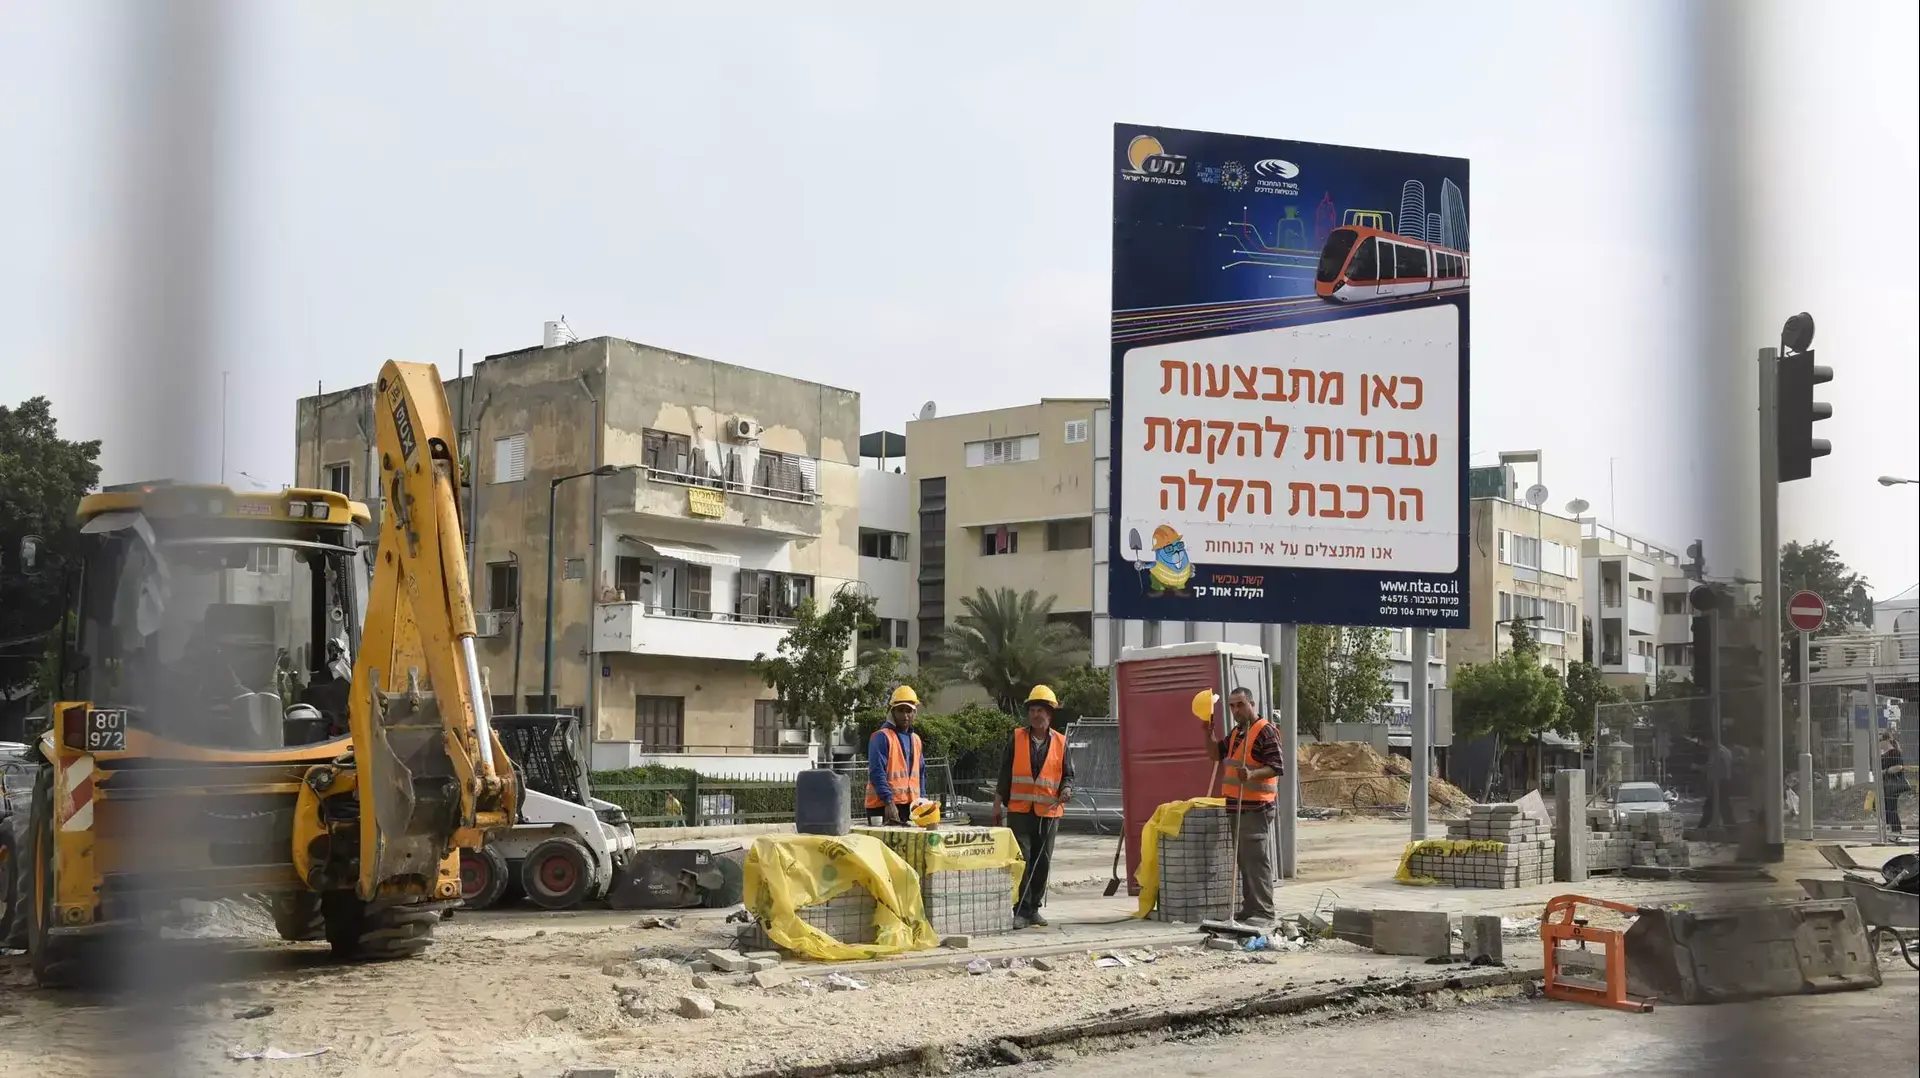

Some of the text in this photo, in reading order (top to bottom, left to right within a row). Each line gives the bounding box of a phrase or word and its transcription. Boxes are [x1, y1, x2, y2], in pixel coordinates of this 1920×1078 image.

[1122, 174, 1140, 182] ישראל
[1257, 179, 1281, 187] התחבורה
[1160, 360, 1424, 416] כאן מתבצעות
[1144, 416, 1438, 467] עבודות להקמת
[1160, 468, 1424, 522] הרכבת הקלה
[1205, 539, 1392, 560] אנו מתנצלים על אי הנוחות
[1212, 574, 1264, 587] קשה עכשיו
[1380, 578, 1459, 594] www.nta.co.il
[1193, 585, 1264, 598] הקלה אחר כך
[1410, 595, 1438, 604] הציבור:
[1440, 597, 1459, 605] פניות
[1380, 606, 1398, 615] פלוס
[1440, 609, 1459, 618] מוקד
[96, 713, 118, 729] 80
[90, 732, 123, 747] 972
